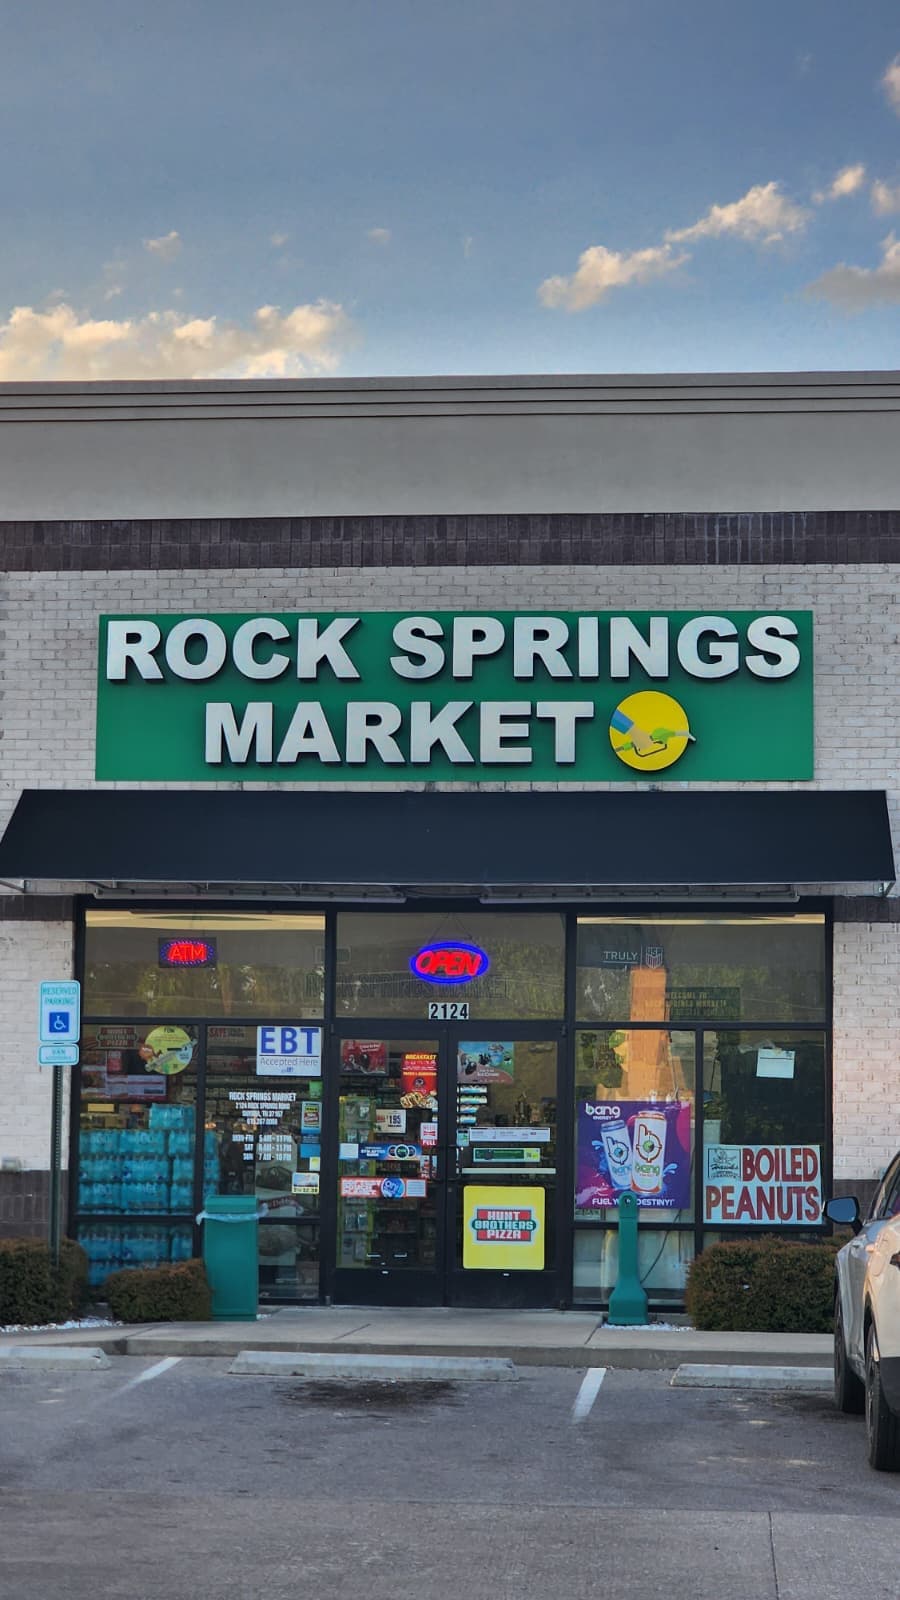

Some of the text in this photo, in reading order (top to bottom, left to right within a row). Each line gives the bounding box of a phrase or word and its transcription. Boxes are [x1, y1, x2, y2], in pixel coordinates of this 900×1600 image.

[105, 615, 801, 681] ROCK SPRINGS
[204, 700, 595, 765] MARKET
[168, 943, 208, 960] ATM
[603, 951, 639, 960] TRULY
[415, 951, 482, 976] OPEN
[42, 987, 77, 995] RESERVED
[45, 997, 75, 1005] PARKING
[430, 1003, 468, 1019] 2124
[260, 1026, 319, 1054] EBT
[260, 1057, 319, 1067] Accepted Here
[229, 1092, 297, 1102] ROCK SPRINGS MARKET
[585, 1103, 621, 1119] bang
[742, 1147, 818, 1182] BOILED
[705, 1185, 820, 1221] PEANUTS
[487, 1211, 520, 1220] HUNT
[474, 1220, 534, 1230] BROTHERS
[486, 1230, 521, 1239] PIZZA
